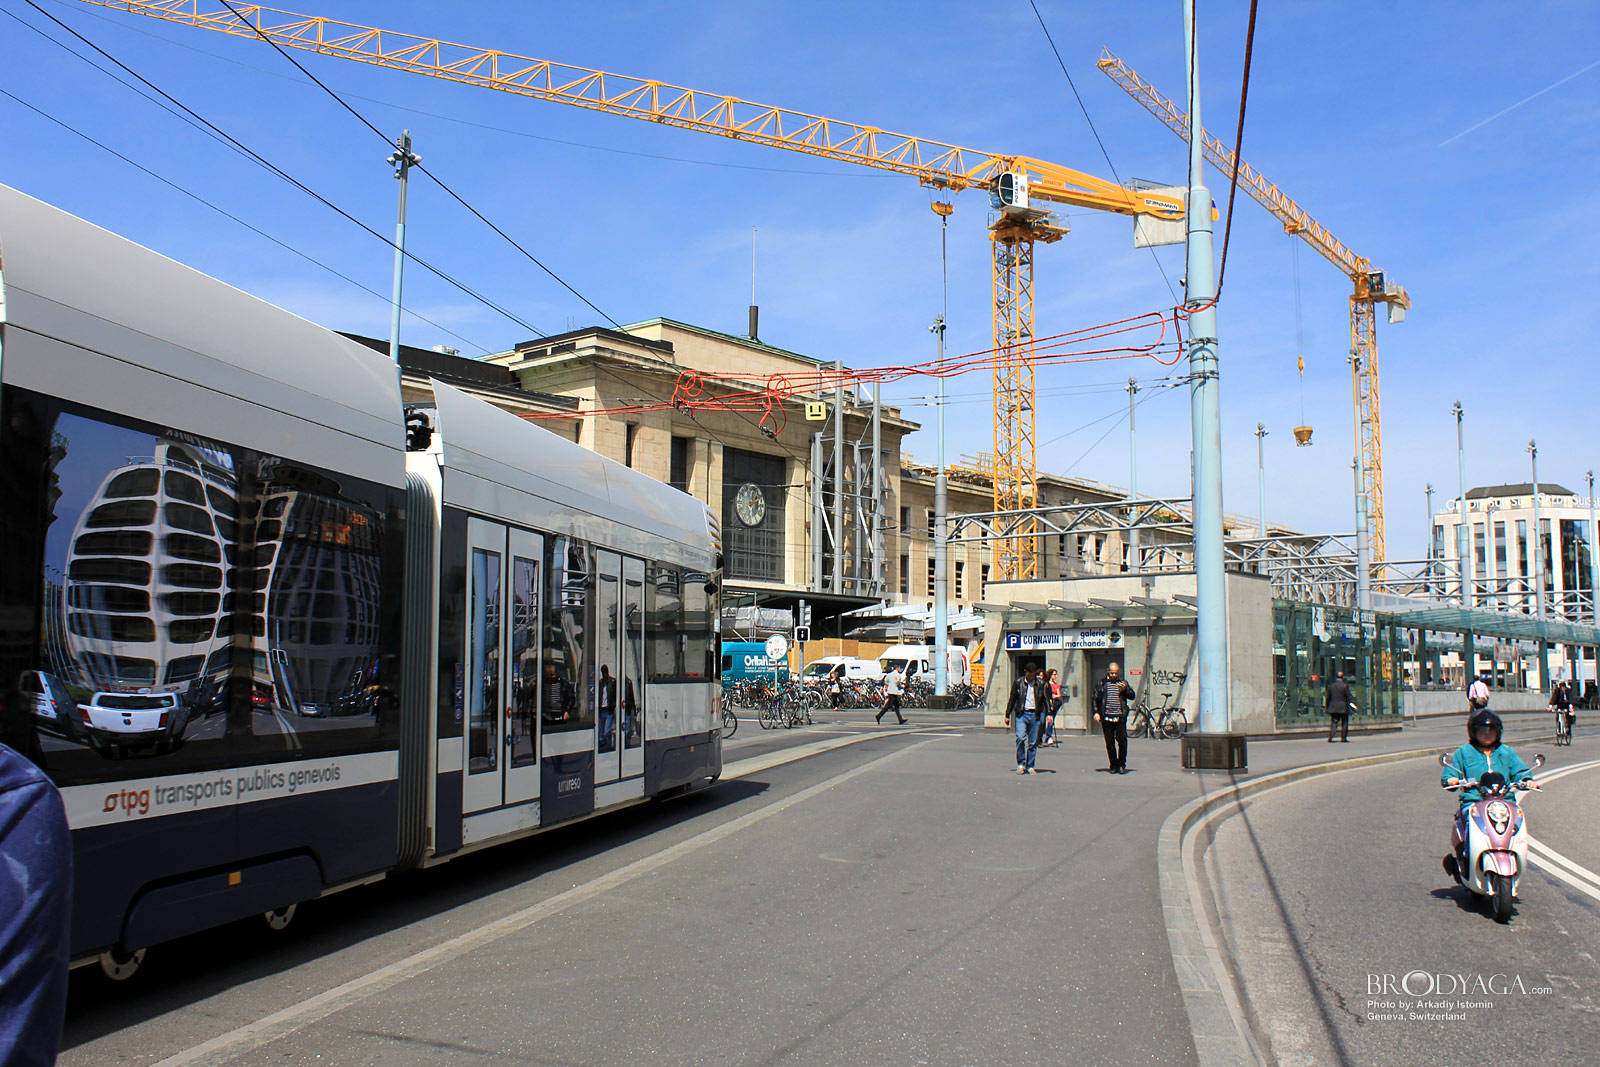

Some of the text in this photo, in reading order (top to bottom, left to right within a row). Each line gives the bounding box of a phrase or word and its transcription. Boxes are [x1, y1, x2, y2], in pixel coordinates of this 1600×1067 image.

[1080, 629, 1106, 640] galerie
[1023, 635, 1059, 645] CORNAVIN
[1065, 639, 1106, 648] marchande
[155, 777, 233, 807] transports
[236, 767, 285, 800] publics
[288, 763, 341, 793] genevois
